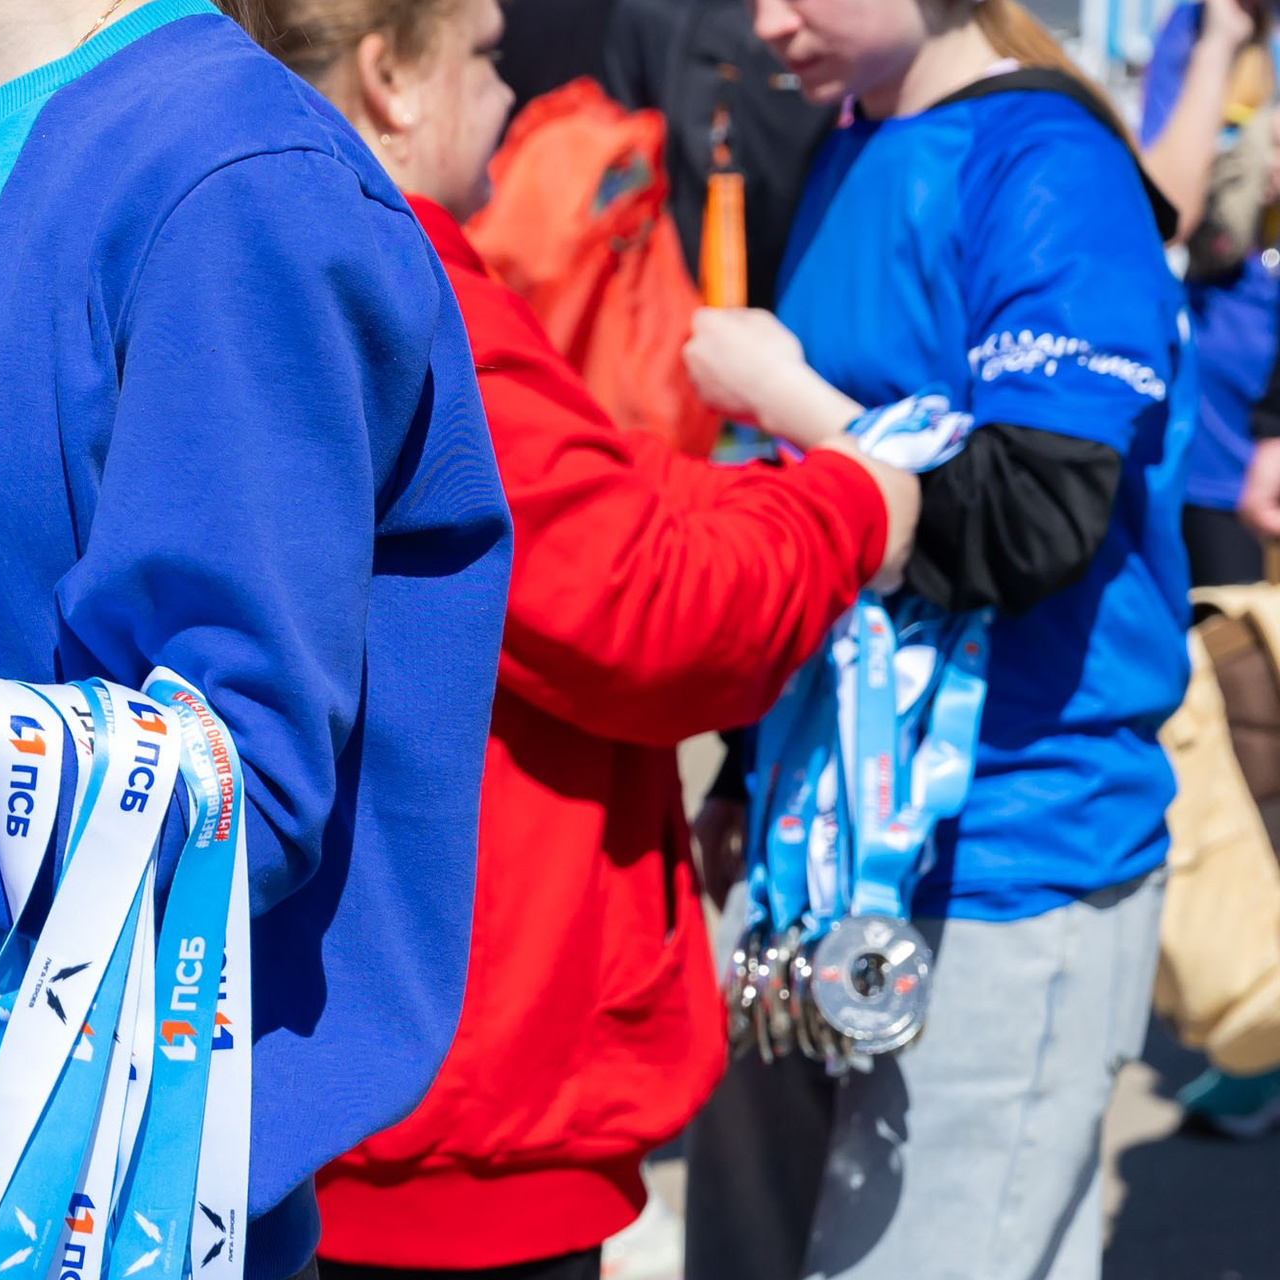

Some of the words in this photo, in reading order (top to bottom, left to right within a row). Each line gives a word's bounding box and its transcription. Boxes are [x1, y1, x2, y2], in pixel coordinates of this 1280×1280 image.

[120, 739, 160, 813] ПСБ
[207, 729, 232, 775] ДАВНО
[6, 764, 38, 838] ПСБ
[171, 935, 206, 1011] ПСБ
